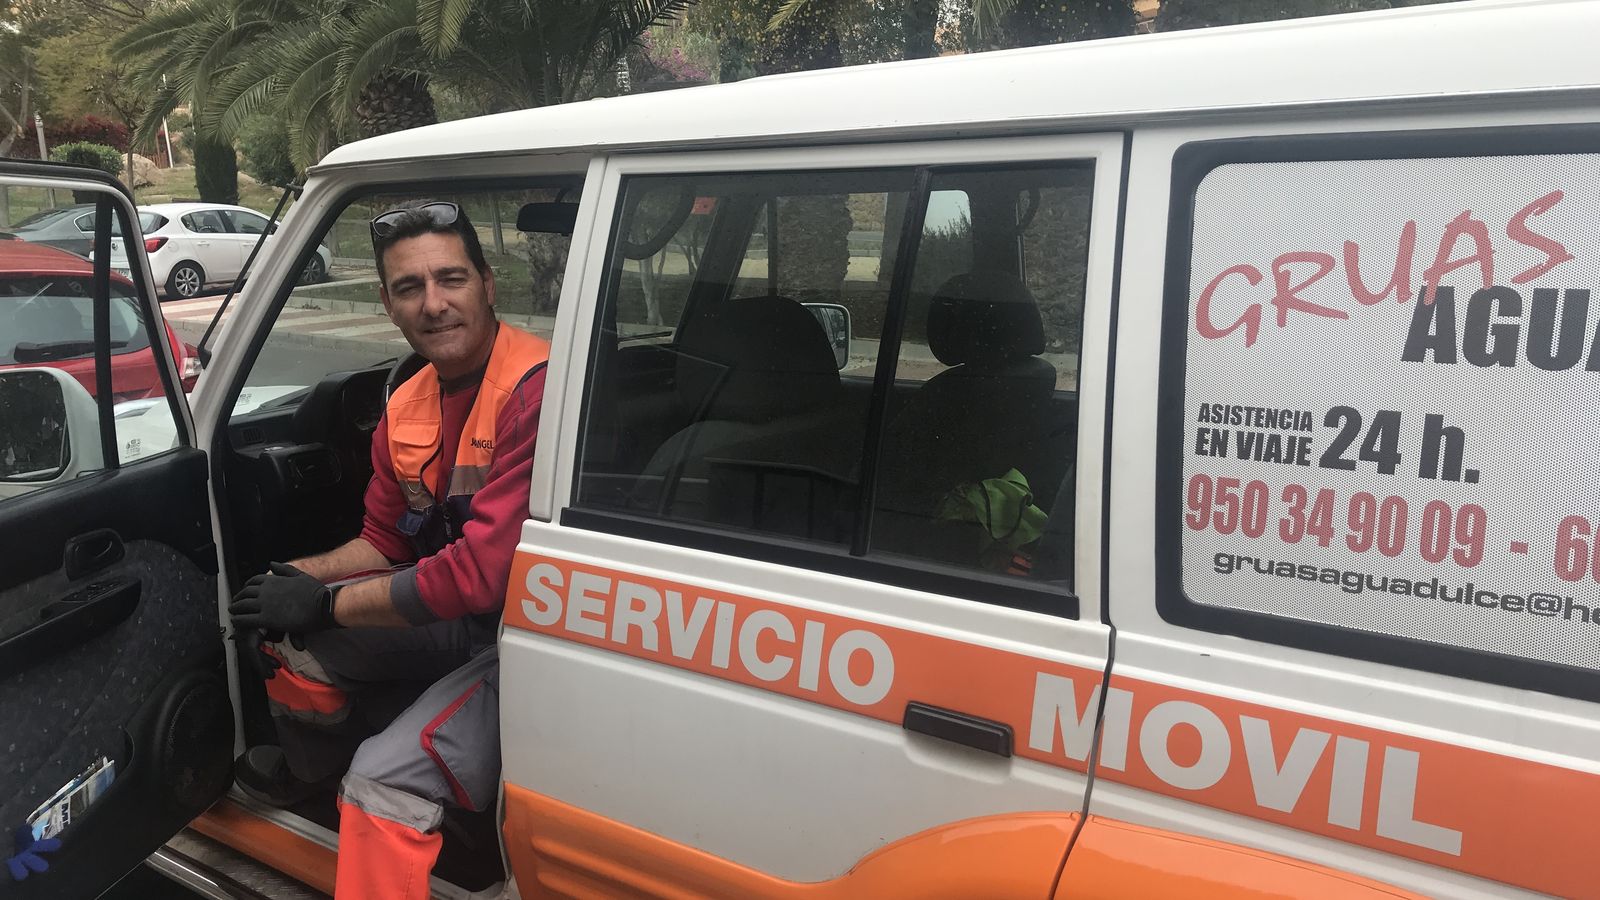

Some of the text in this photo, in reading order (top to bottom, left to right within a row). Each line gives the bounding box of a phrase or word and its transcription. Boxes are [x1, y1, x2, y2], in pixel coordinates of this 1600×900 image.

[1195, 189, 1575, 348] GRUAS
[1194, 427, 1313, 467] EN VIAJE
[1197, 402, 1313, 433] ASISTENCIA
[1318, 405, 1480, 483] 24 h.
[1184, 472, 1270, 540] 950
[1278, 483, 1336, 549] 34
[1345, 491, 1408, 558] 90
[1418, 498, 1487, 568] 09
[1553, 514, 1600, 585] 6
[520, 562, 1463, 856] SERVICIO MOVIL
